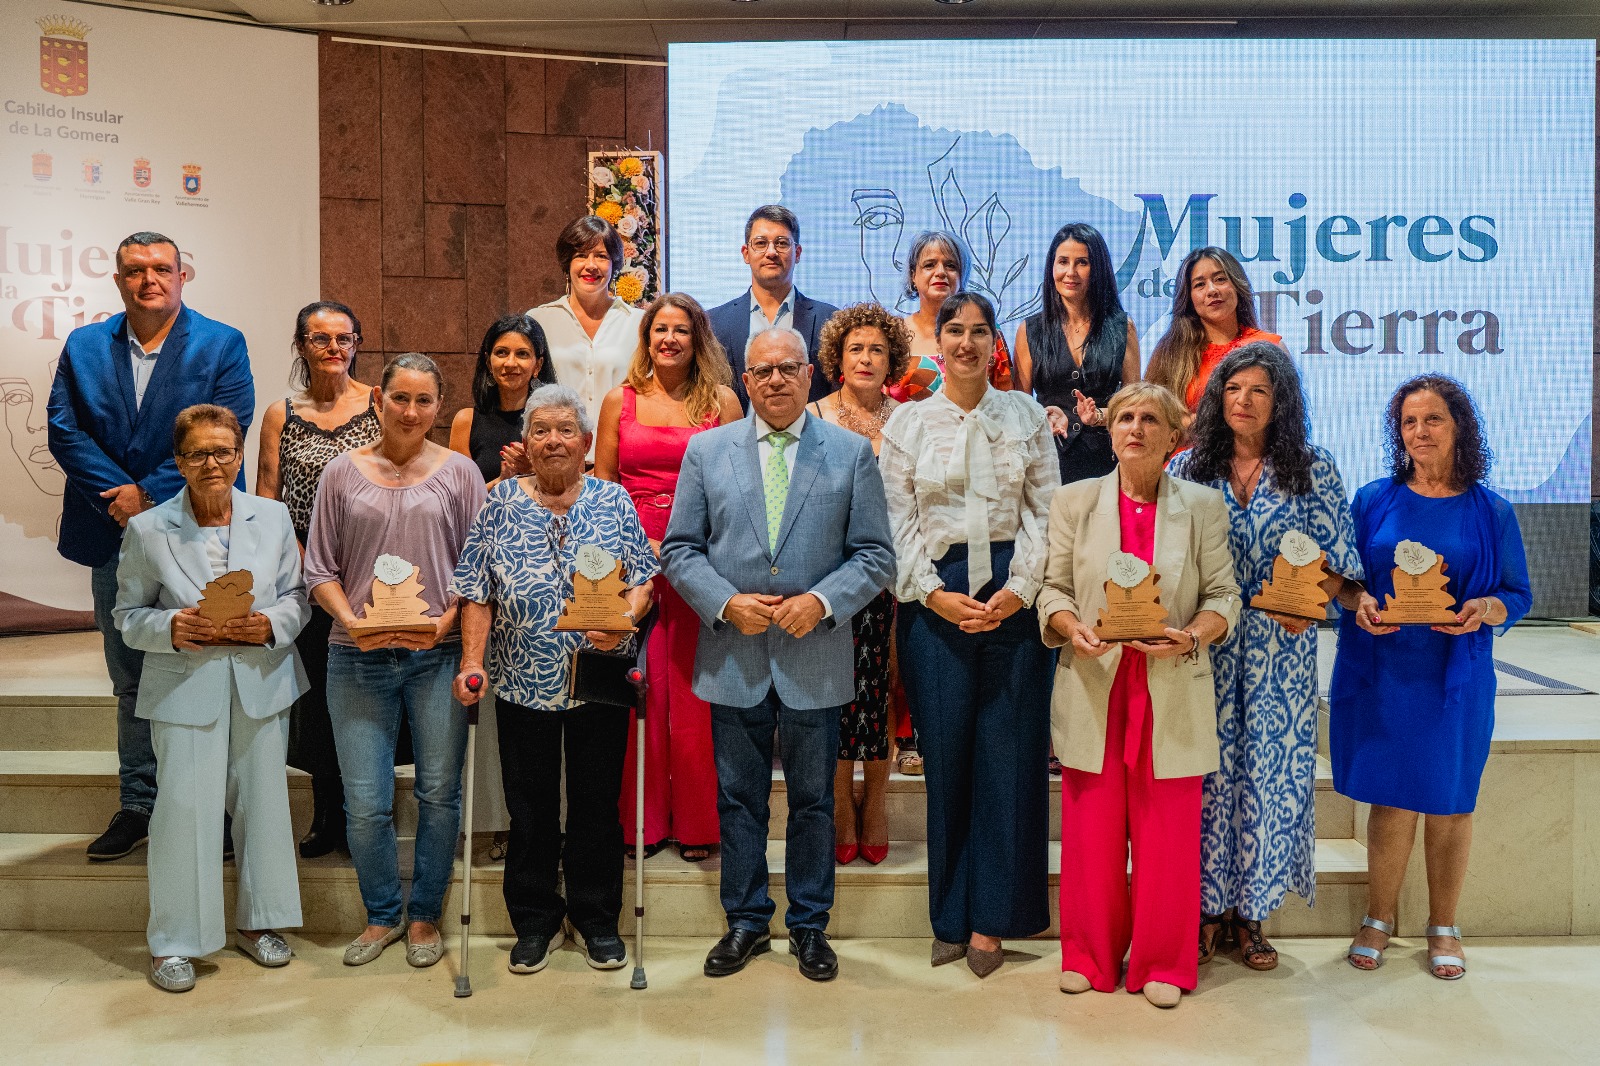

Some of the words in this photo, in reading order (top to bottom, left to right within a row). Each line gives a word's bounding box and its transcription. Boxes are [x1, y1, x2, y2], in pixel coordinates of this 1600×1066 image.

[4, 100, 66, 119] Cabildo
[71, 106, 124, 125] Insular
[9, 120, 29, 135] de
[34, 123, 52, 138] La
[57, 125, 119, 144] Gomera
[1116, 192, 1499, 285] Mujeres
[1251, 289, 1505, 356] Tierra
